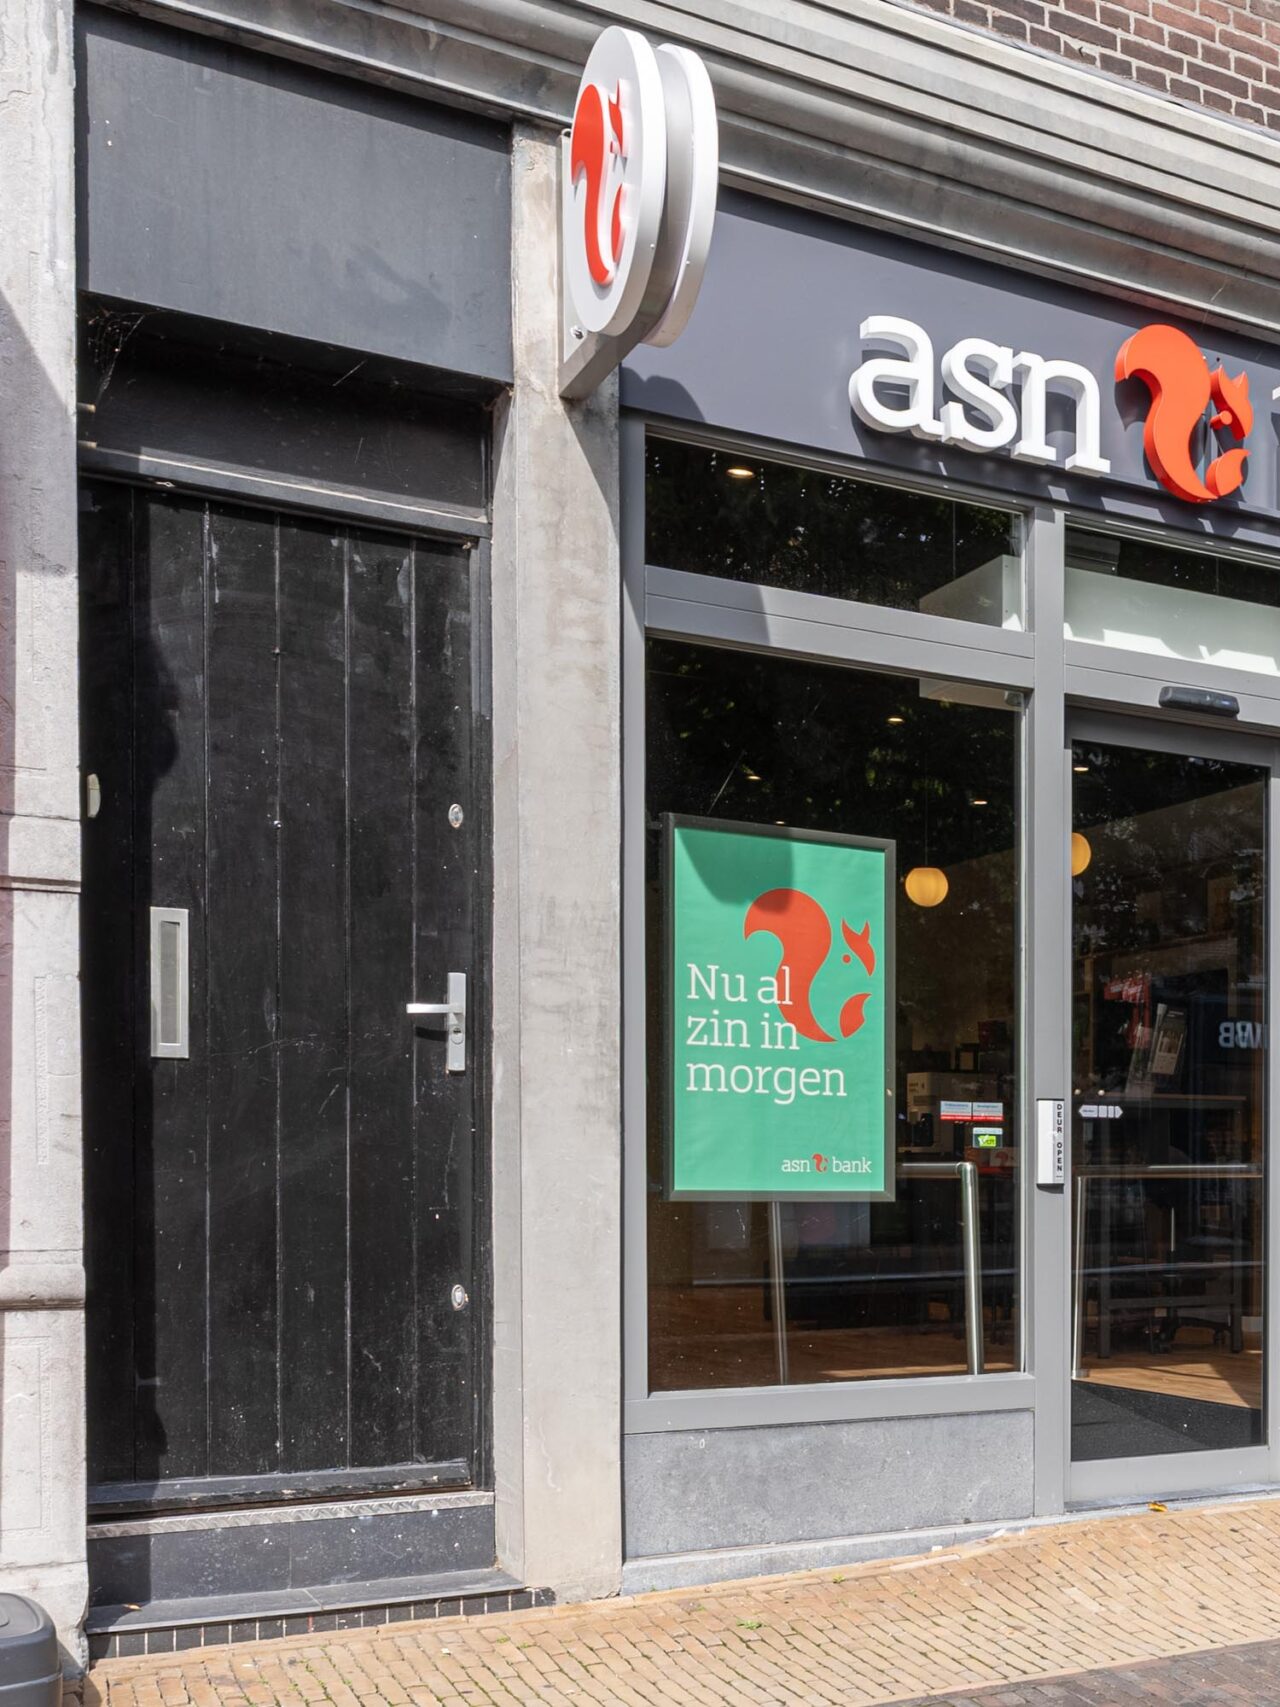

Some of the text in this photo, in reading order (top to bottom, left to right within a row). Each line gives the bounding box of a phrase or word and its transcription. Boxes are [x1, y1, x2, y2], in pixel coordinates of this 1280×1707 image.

[849, 315, 1111, 475] asn
[686, 963, 793, 1005] Nu al
[686, 1009, 800, 1050] zin in
[686, 1061, 847, 1105] morgen
[781, 1157, 872, 1173] asn bank
